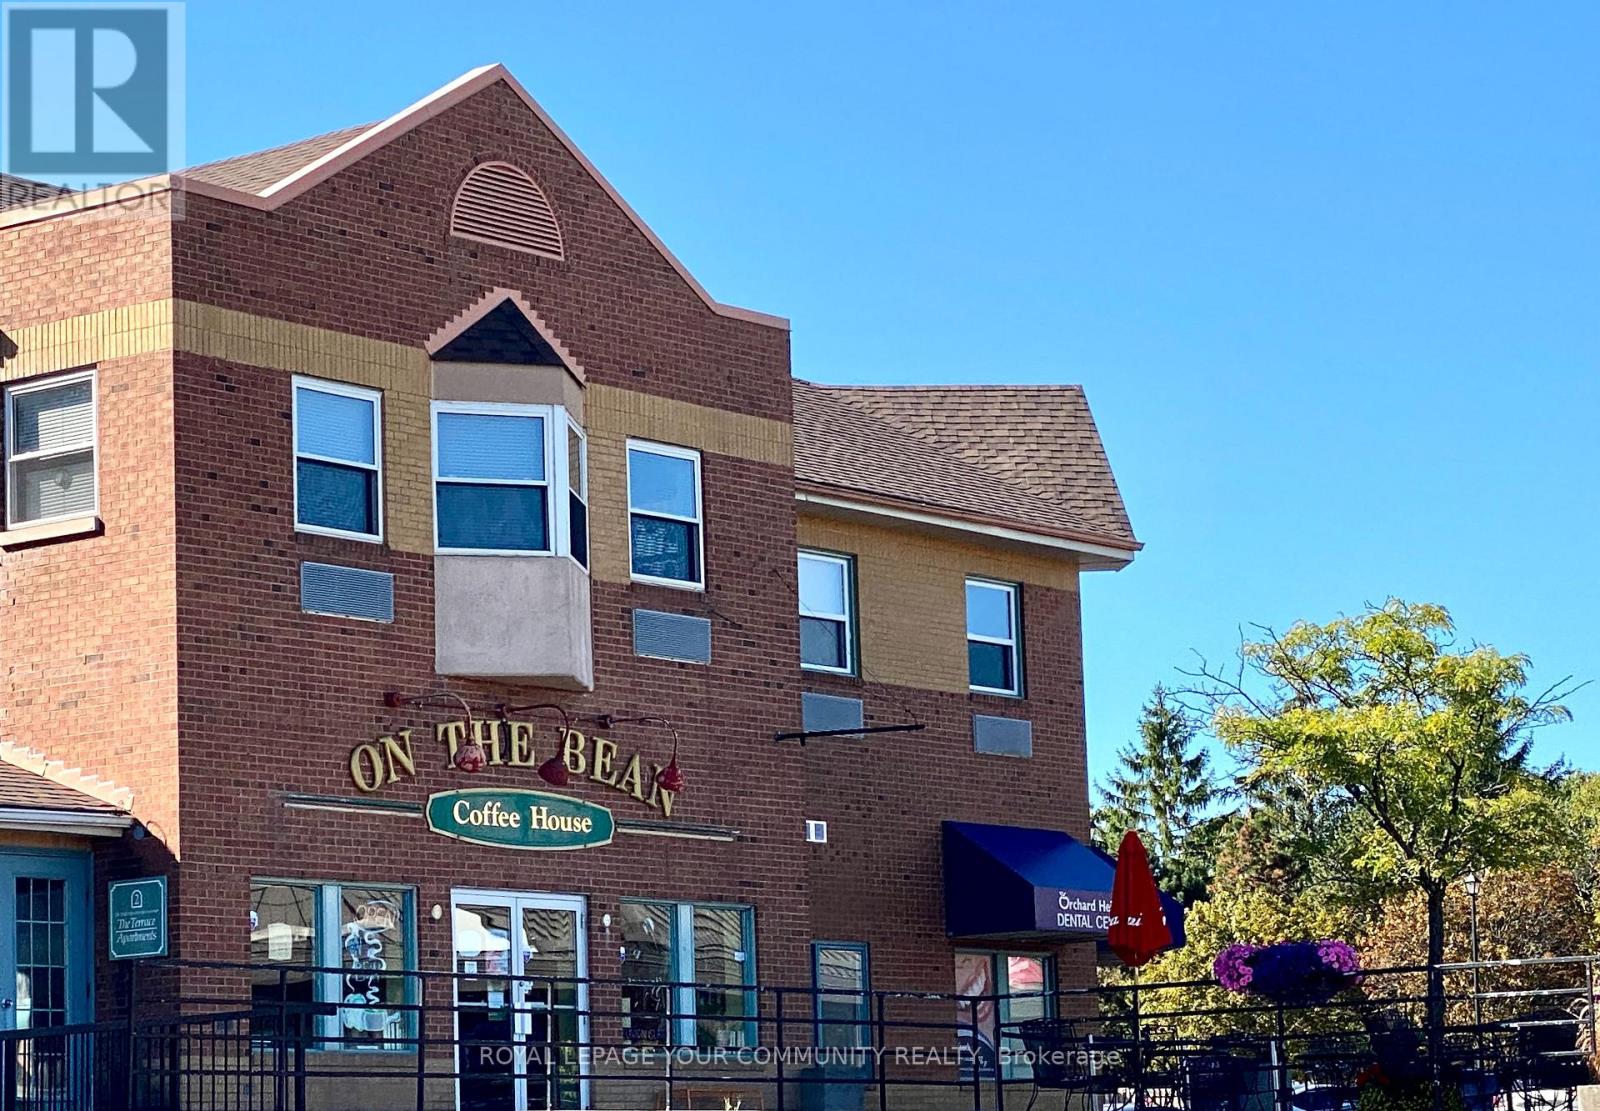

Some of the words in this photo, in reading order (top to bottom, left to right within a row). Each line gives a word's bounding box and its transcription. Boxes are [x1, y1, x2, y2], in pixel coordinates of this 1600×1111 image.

[350, 729, 416, 793] ON
[435, 719, 537, 769] THE
[558, 726, 677, 818] BEAN
[453, 800, 521, 828] Coffee
[530, 805, 593, 834] House
[1058, 891, 1096, 912] Orchard
[1098, 900, 1113, 913] Hei
[1057, 913, 1093, 929] DENTAL
[1095, 914, 1110, 930] CE
